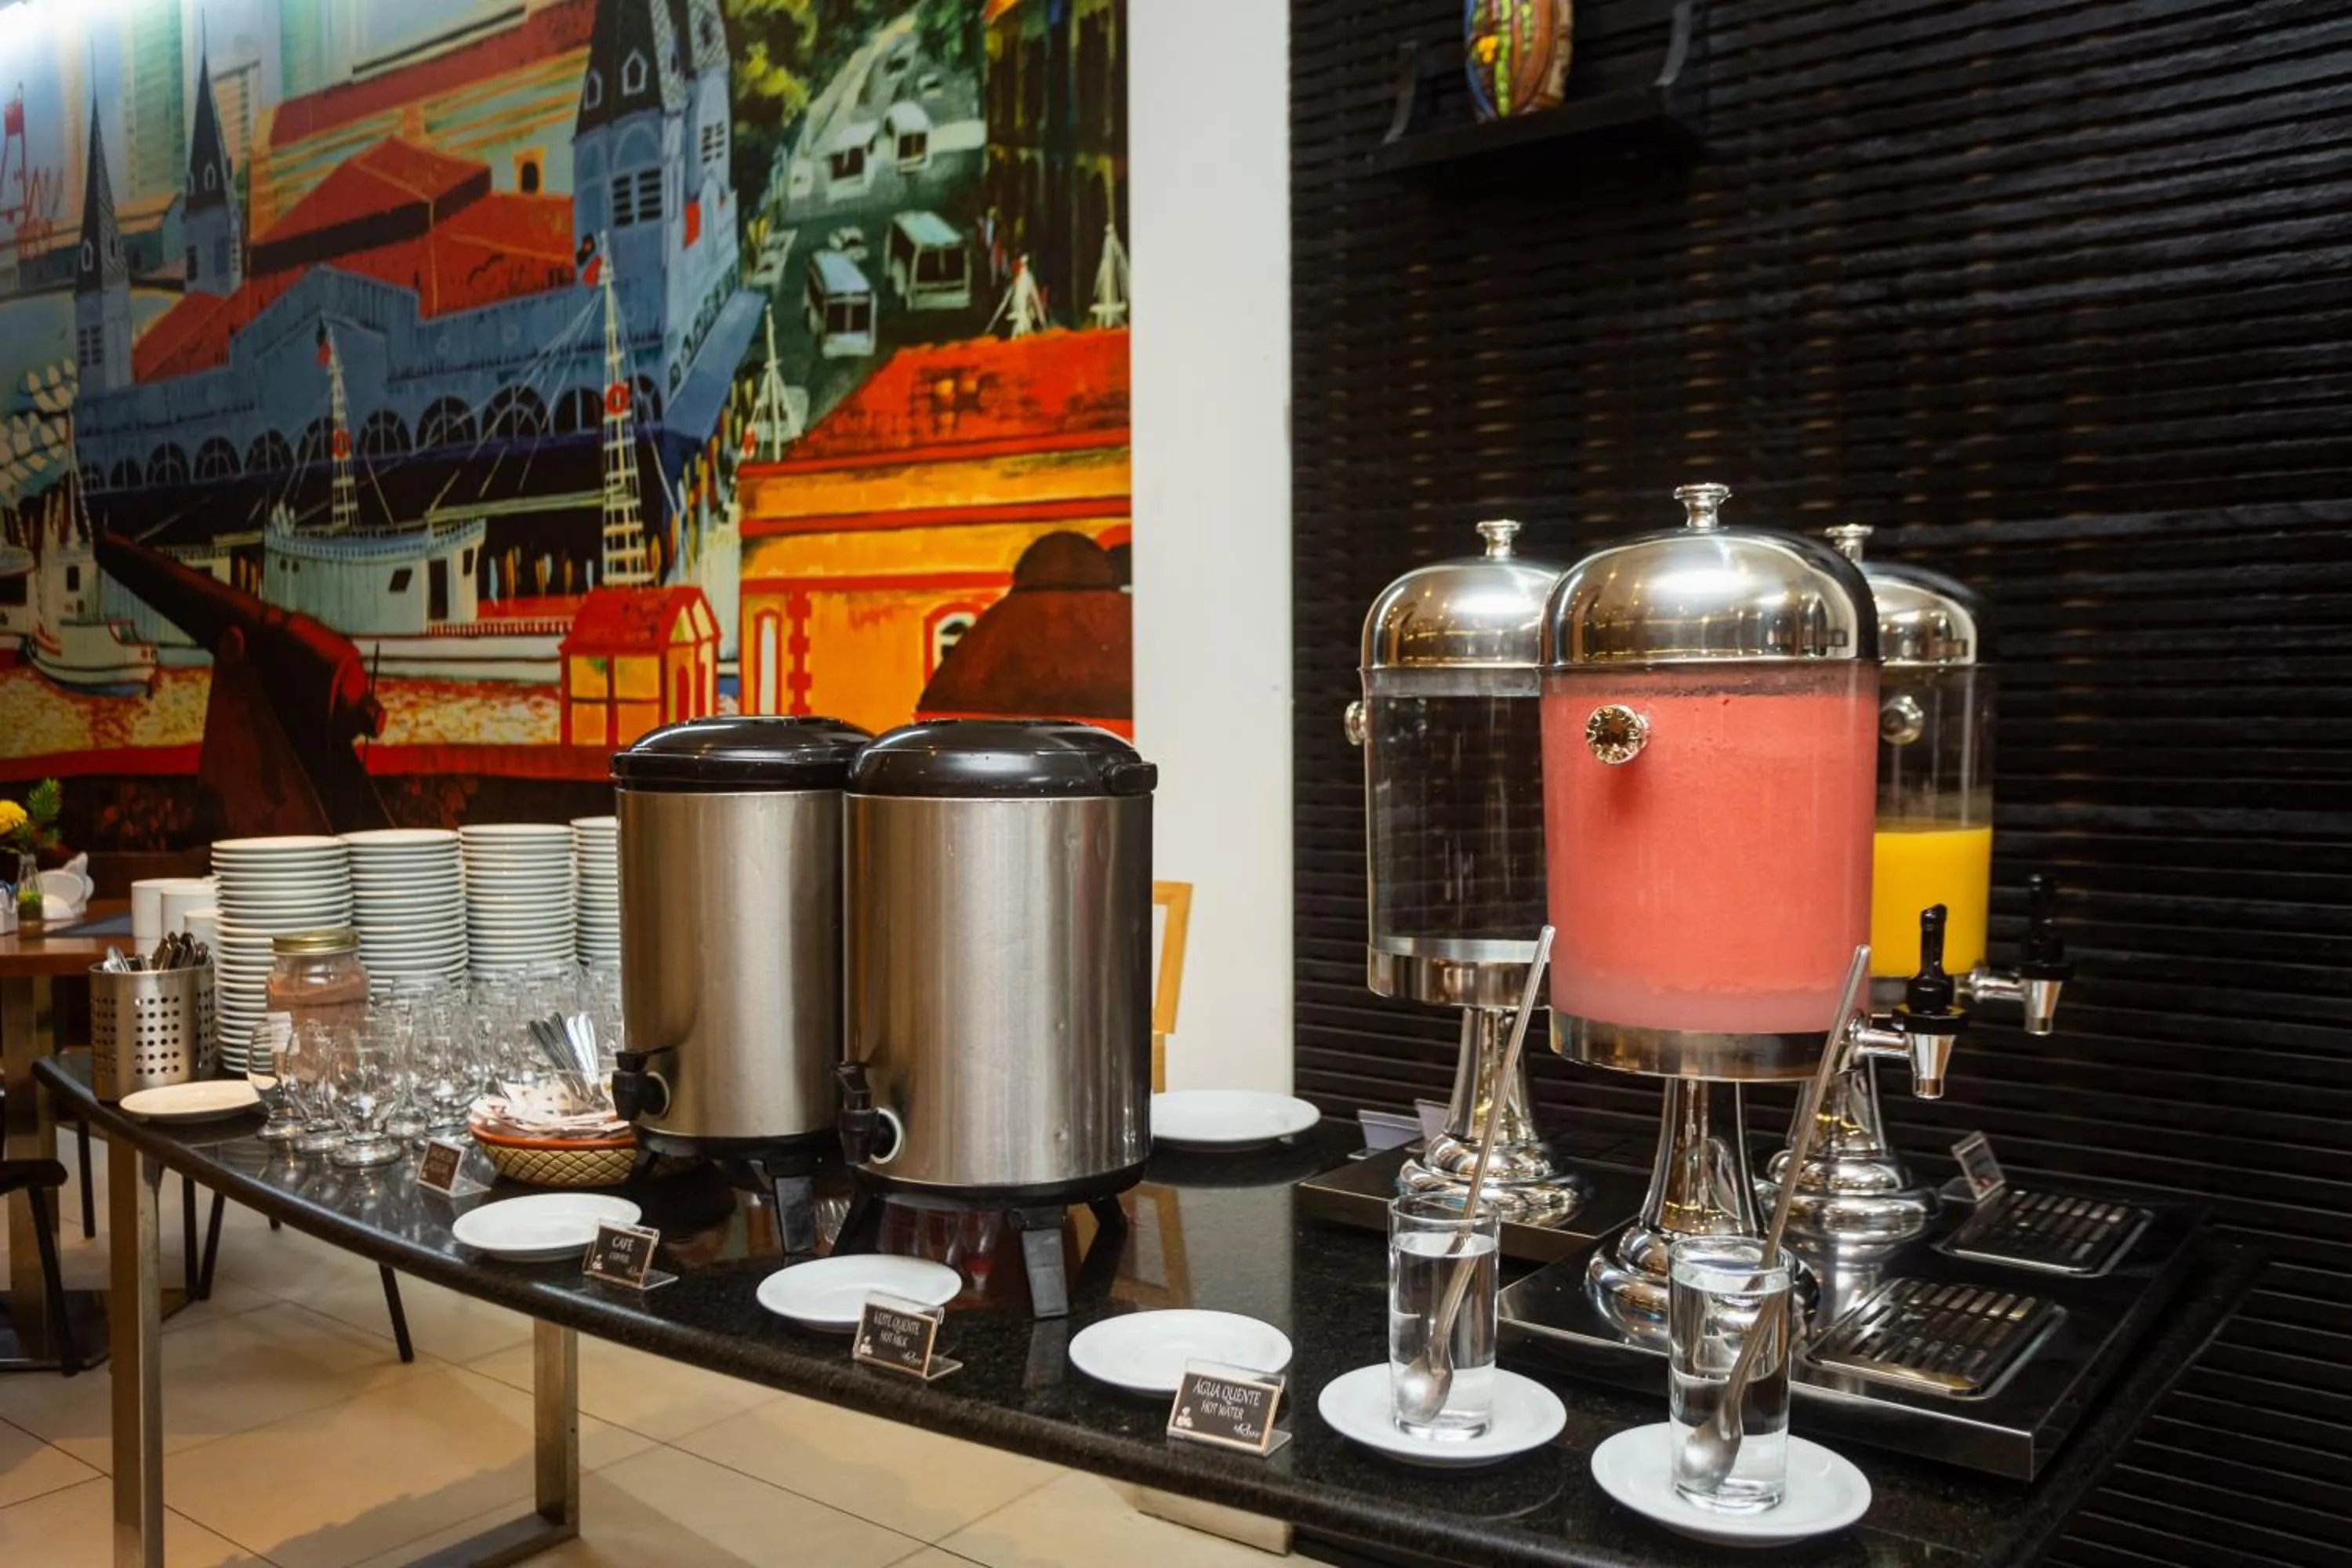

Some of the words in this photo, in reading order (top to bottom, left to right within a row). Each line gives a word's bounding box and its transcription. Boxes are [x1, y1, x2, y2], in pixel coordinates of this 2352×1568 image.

[1221, 1384, 1261, 1406] QUENTE
[1200, 1400, 1218, 1416] HOT
[1218, 1403, 1245, 1421] WATER
